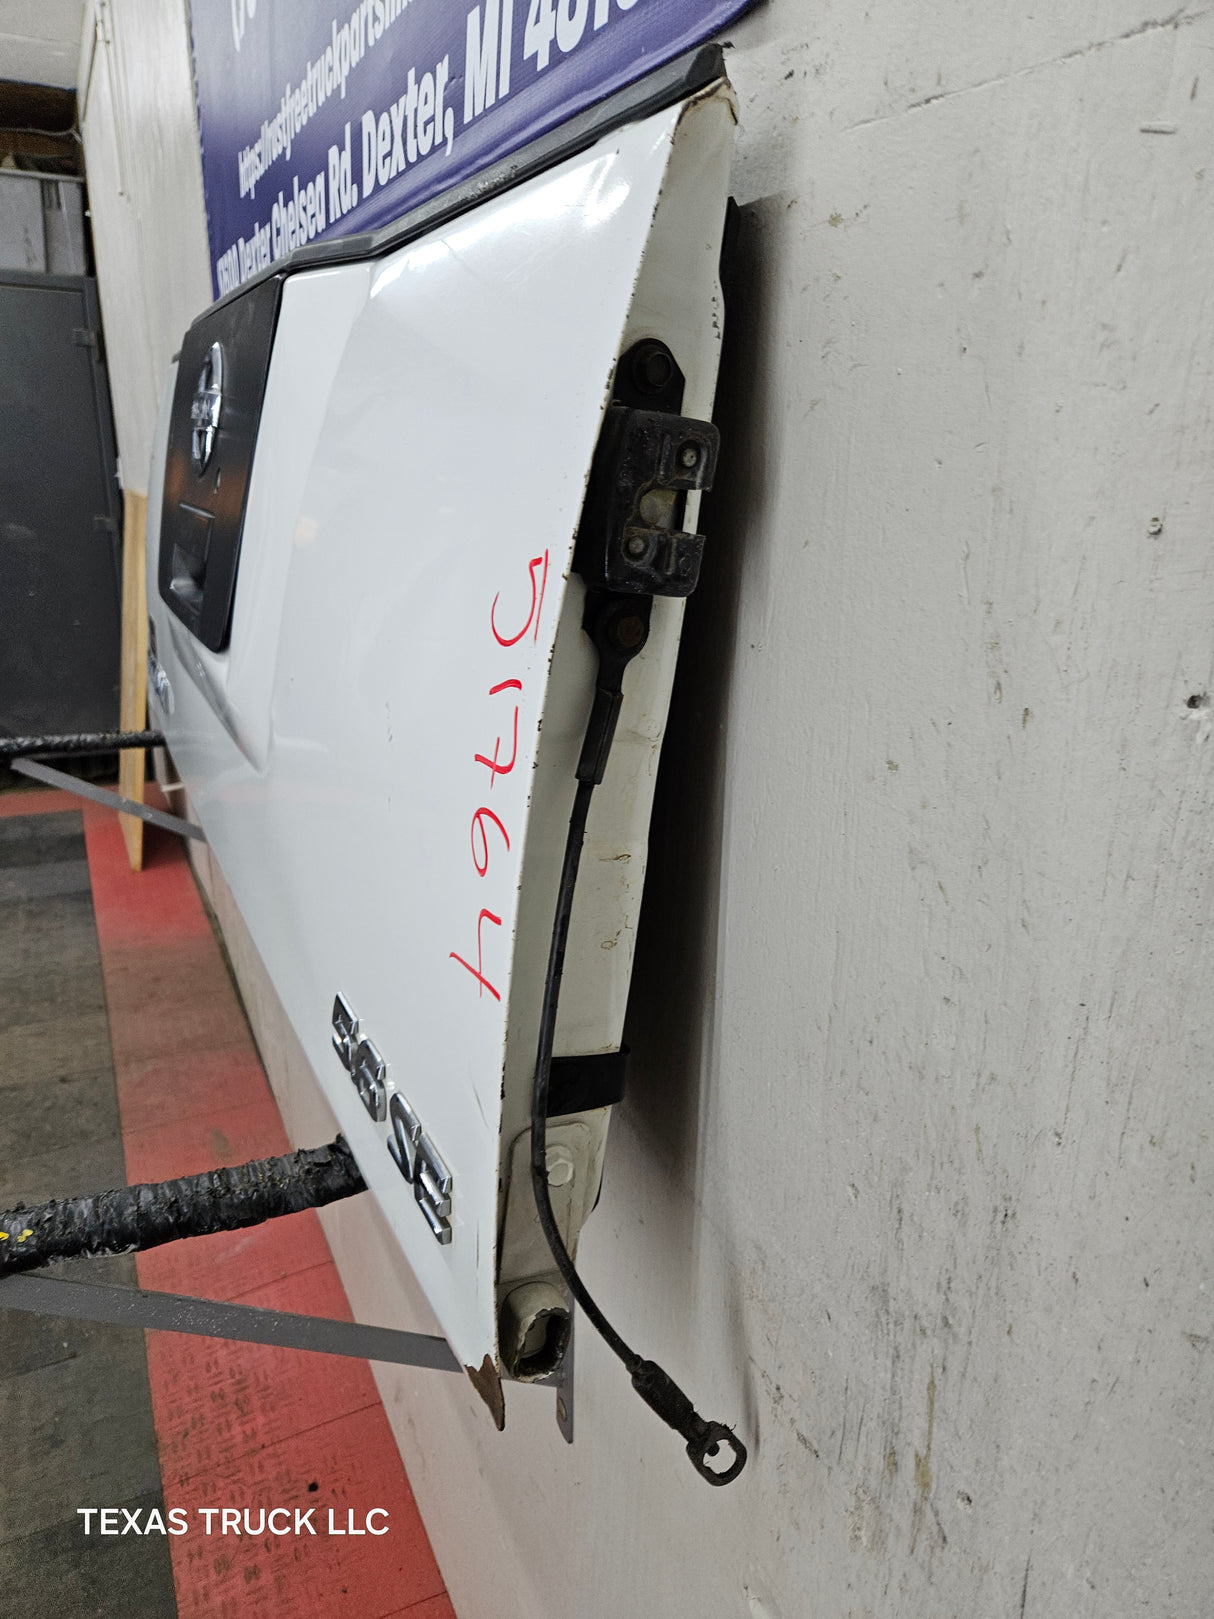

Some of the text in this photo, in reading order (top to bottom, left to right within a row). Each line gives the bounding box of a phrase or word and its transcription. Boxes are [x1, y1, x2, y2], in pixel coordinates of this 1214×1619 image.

[237, 222, 271, 284] Dexter
[272, 171, 326, 260] Chelsea
[328, 122, 358, 223] Rd.
[362, 54, 454, 199] Dexter,
[463, 0, 514, 125] MI
[449, 548, 549, 1002] 51764
